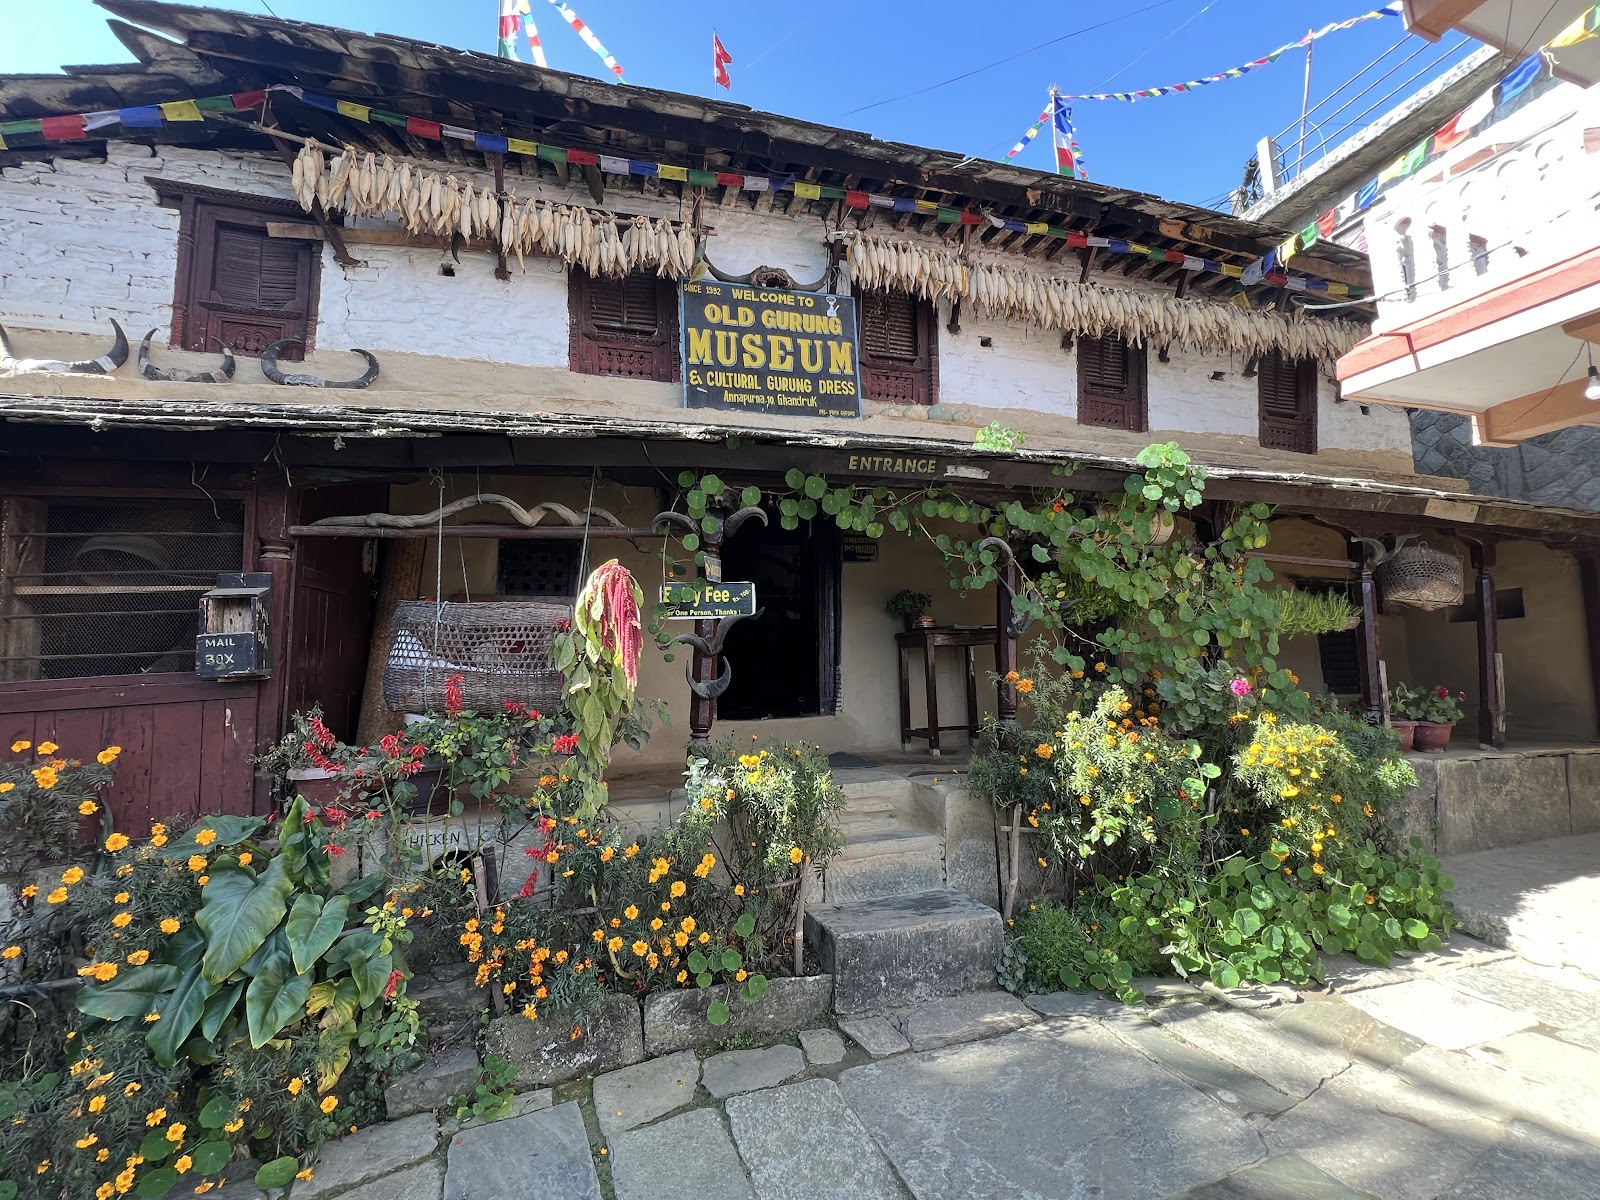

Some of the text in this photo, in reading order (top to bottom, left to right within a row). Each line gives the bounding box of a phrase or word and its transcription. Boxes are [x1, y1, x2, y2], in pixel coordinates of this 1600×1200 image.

[684, 283, 702, 294] SINCE
[732, 289, 814, 308] WELCOME TO
[704, 303, 843, 336] OLD GURUNG
[688, 327, 855, 376] MUSEUM
[689, 369, 856, 396] & CULTURAL GURUNG DRESS
[848, 455, 936, 474] ENTRANCE
[705, 586, 730, 603] Fee
[714, 608, 737, 616] Thanks
[205, 638, 236, 648] MAIL
[205, 653, 235, 665] BOX
